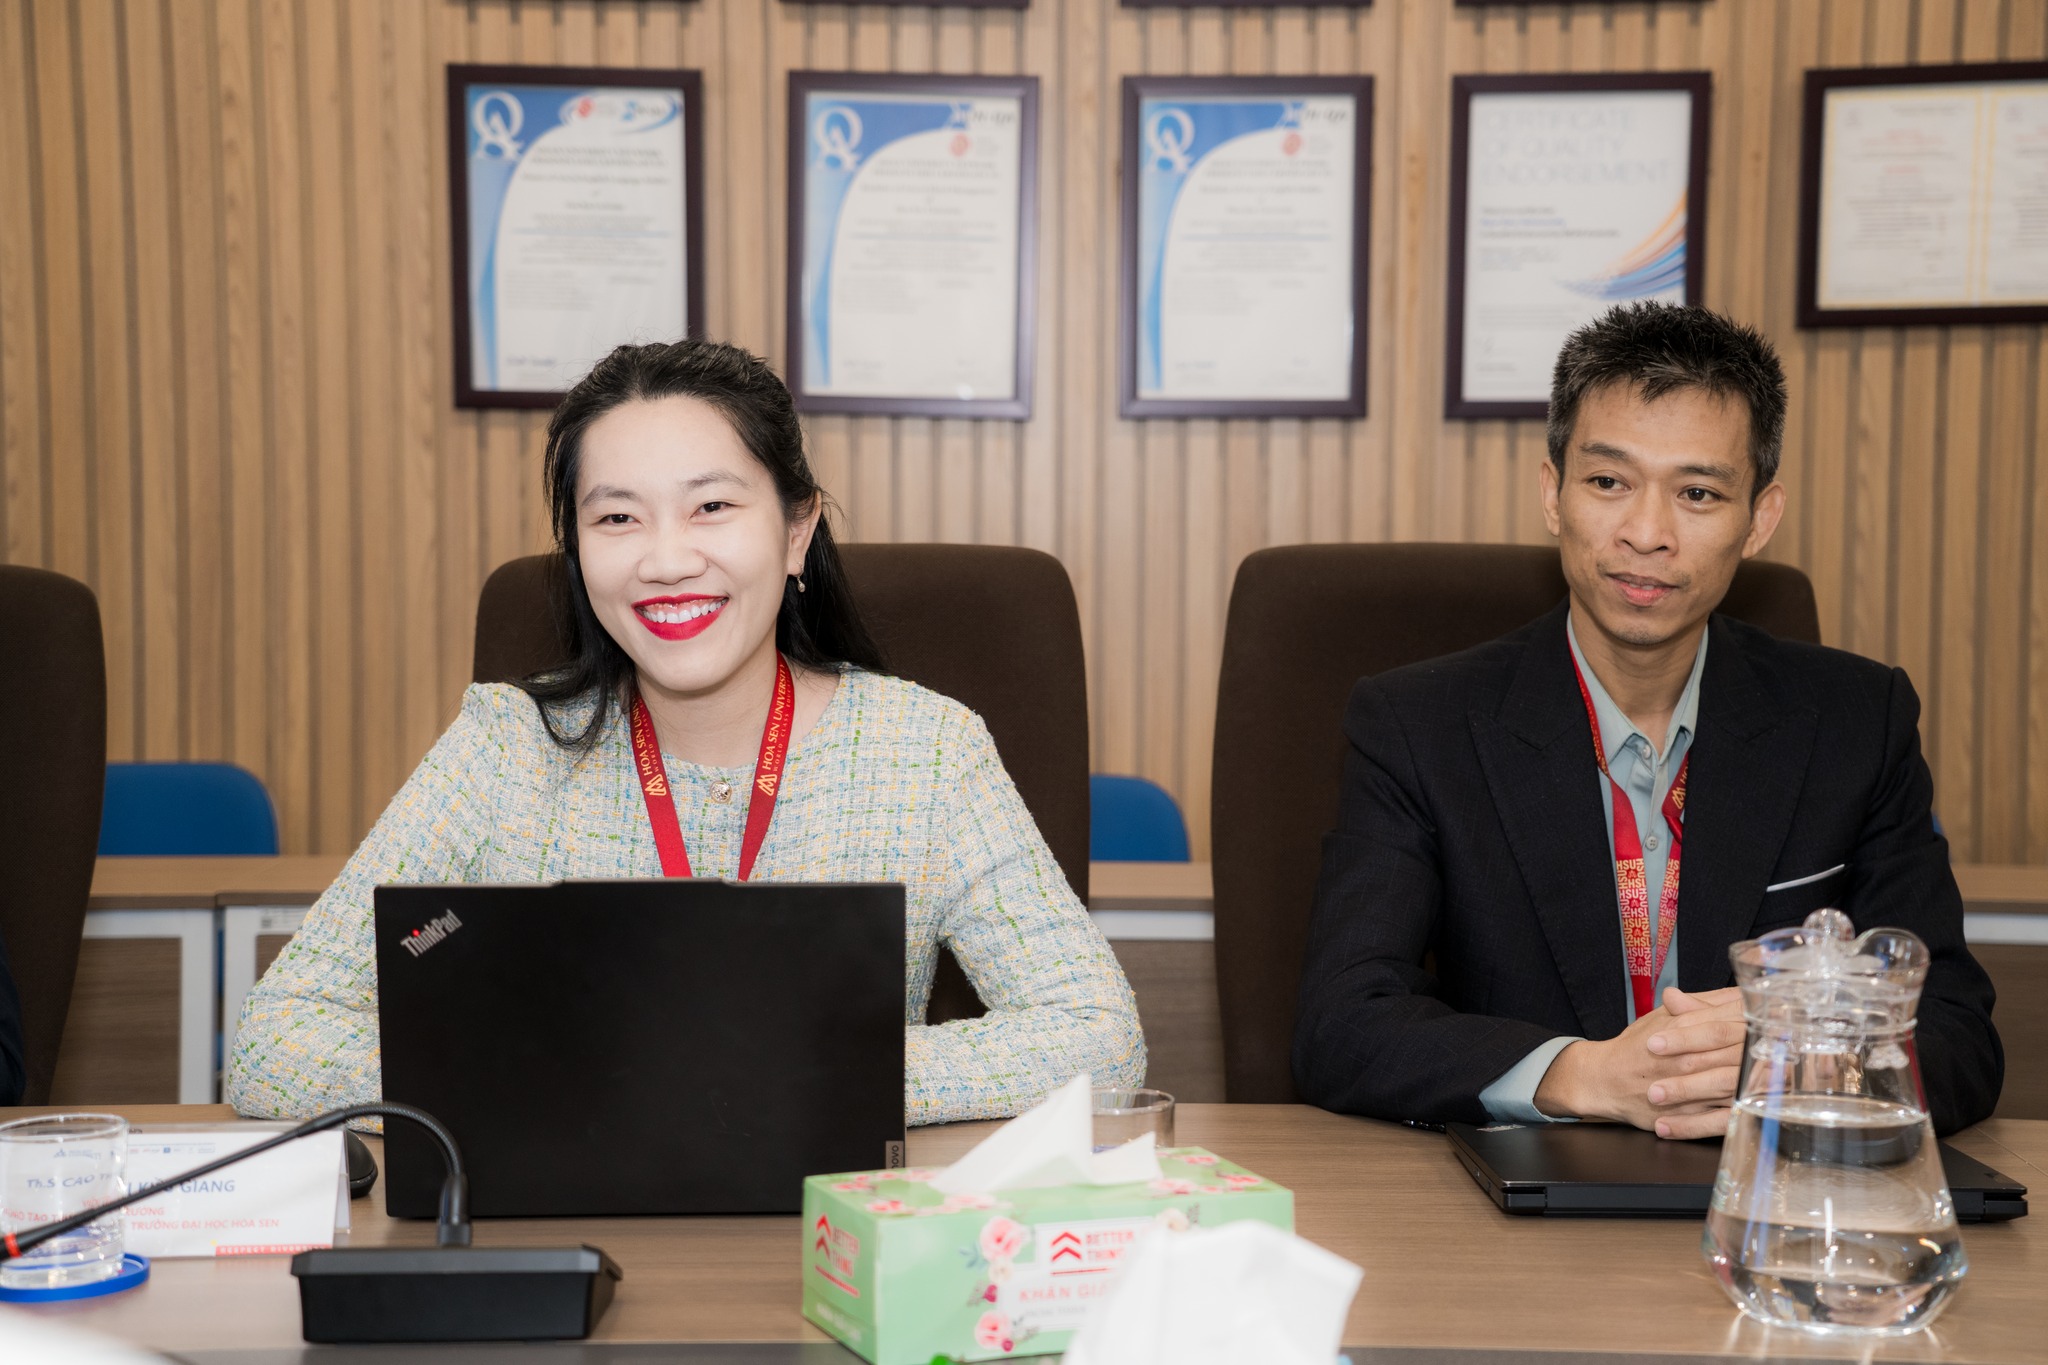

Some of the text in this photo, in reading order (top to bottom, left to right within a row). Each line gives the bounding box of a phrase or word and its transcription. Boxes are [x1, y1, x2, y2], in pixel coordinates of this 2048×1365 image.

[762, 664, 787, 770] HOA SEN UNIVERSITY
[636, 729, 646, 749] SEN
[639, 750, 653, 776] HOA
[773, 743, 783, 772] WORLD
[1616, 859, 1636, 870] HSU
[1667, 858, 1680, 870] HS
[1619, 889, 1639, 899] HSU
[1623, 918, 1642, 928] HSU
[400, 908, 463, 958] ThinkPad
[1626, 947, 1644, 957] HSU
[62, 1174, 95, 1187] CAO
[181, 1179, 235, 1193] GIANG
[259, 1217, 280, 1228] SEN
[1085, 1230, 1134, 1246] BETTER
